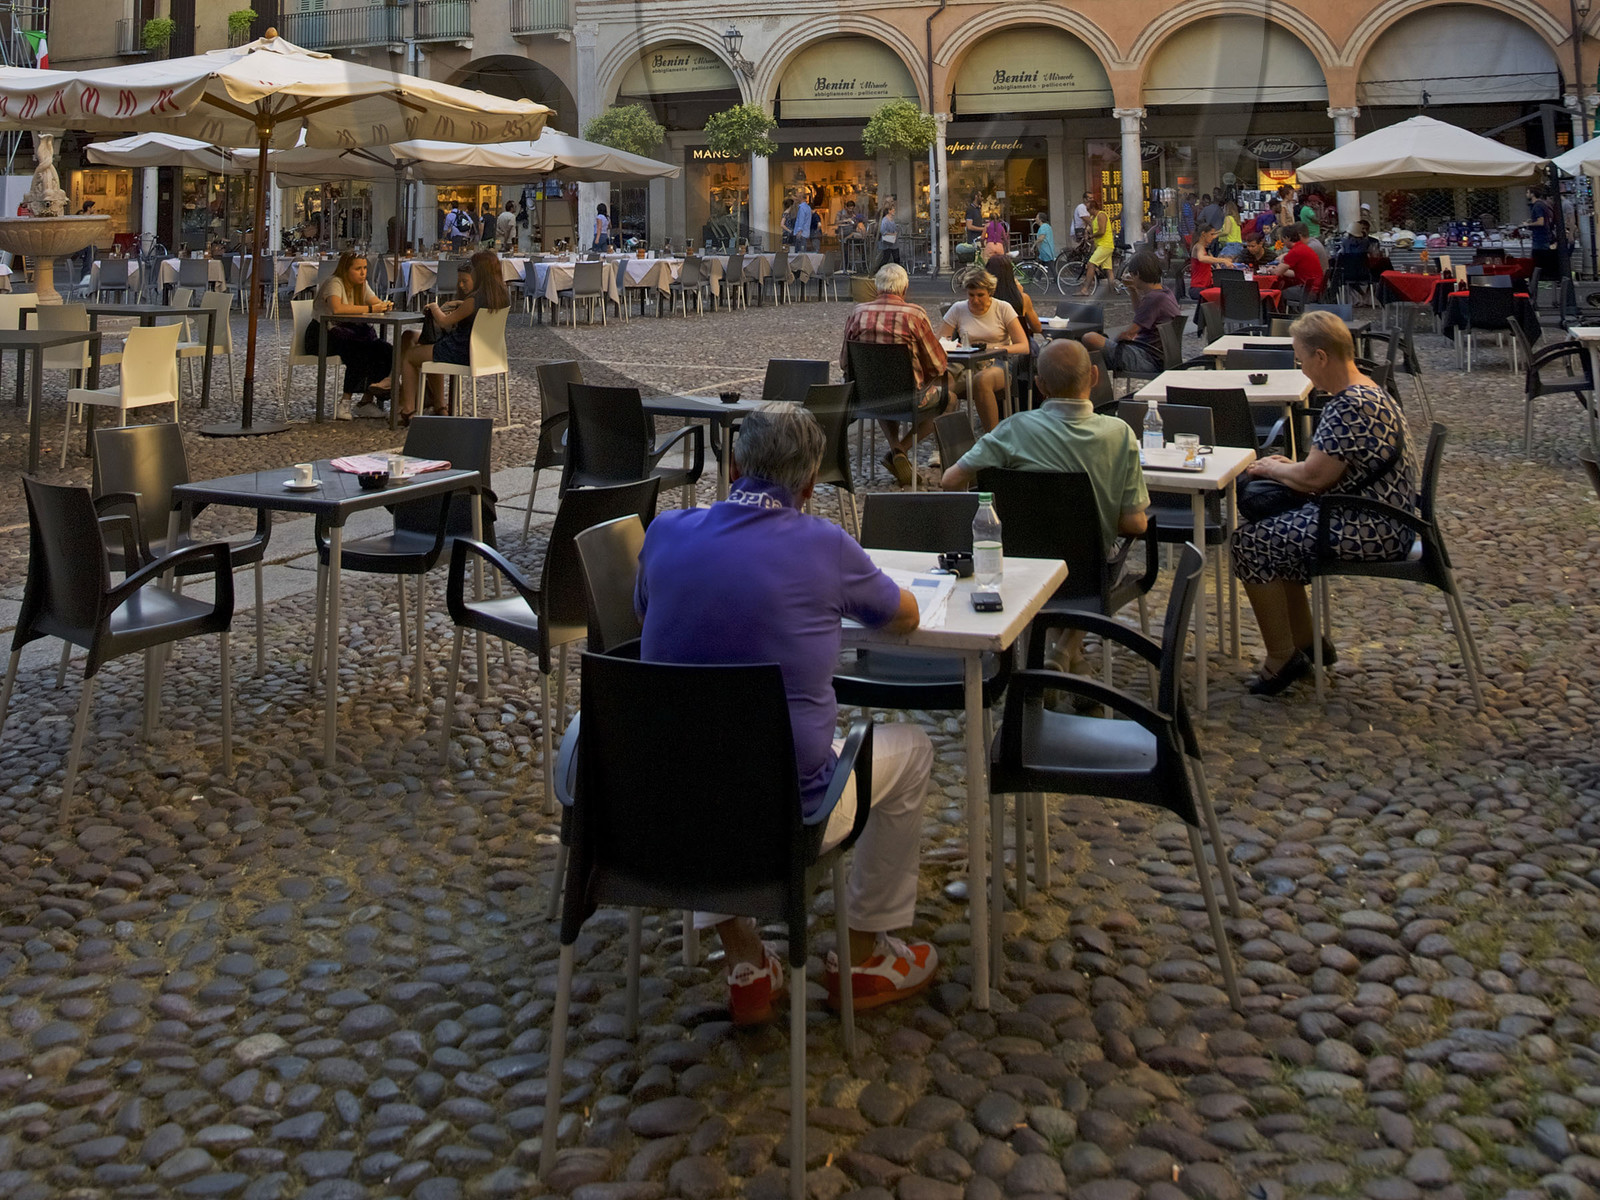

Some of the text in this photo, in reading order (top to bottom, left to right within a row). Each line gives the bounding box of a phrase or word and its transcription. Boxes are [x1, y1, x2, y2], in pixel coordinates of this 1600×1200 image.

[652, 54, 691, 68] Benini
[993, 69, 1039, 84] Benini
[814, 77, 856, 91] Benini
[1041, 81, 1075, 89] pellicceria
[793, 146, 844, 157] MANGO
[945, 141, 975, 155] apori
[976, 142, 988, 150] in
